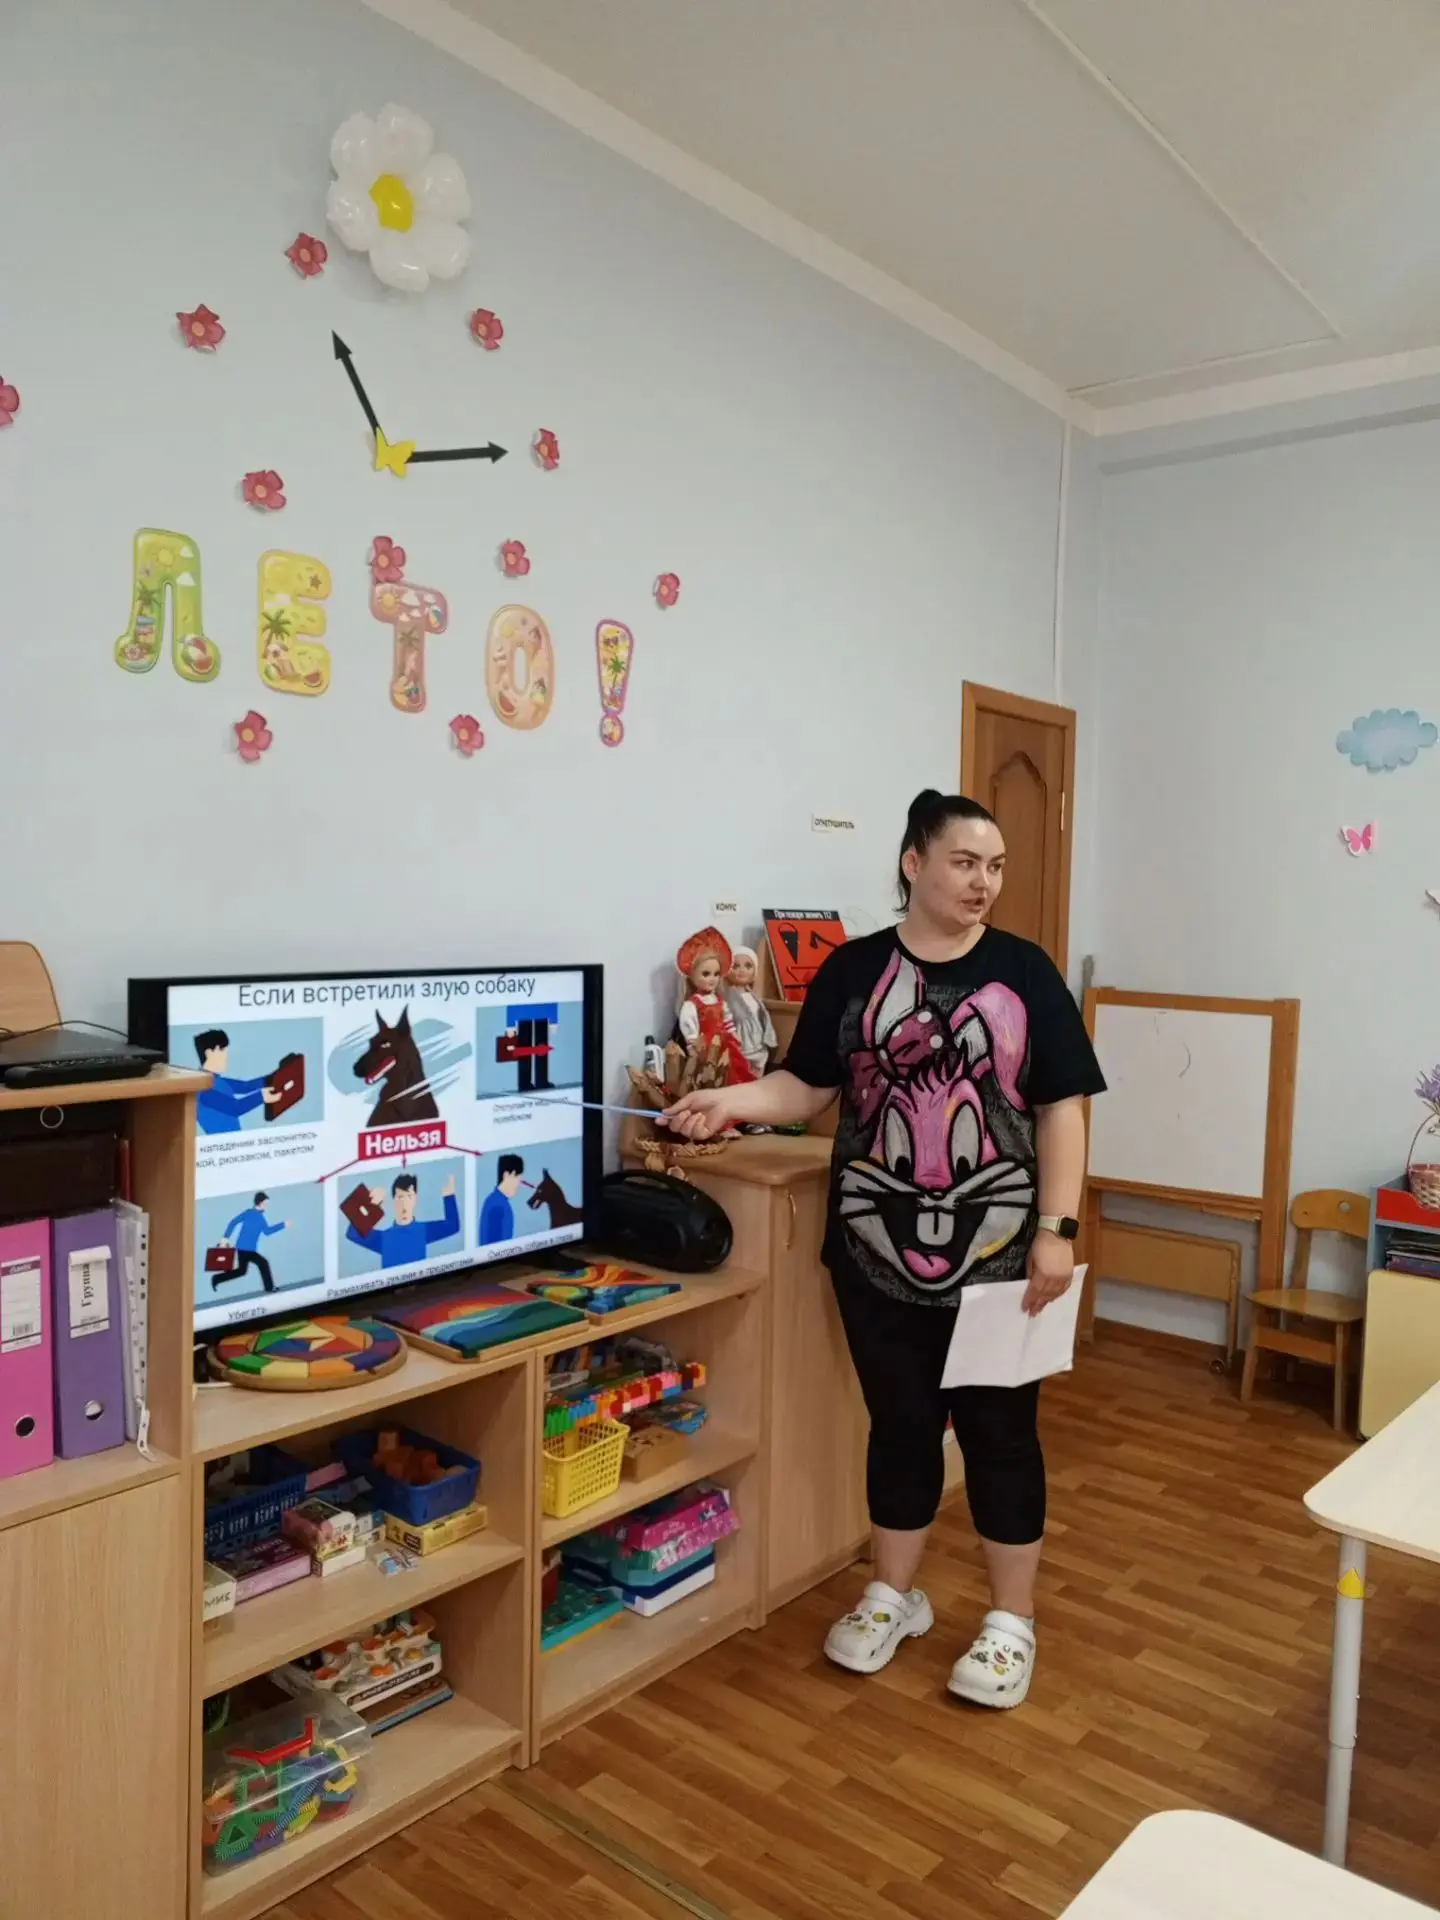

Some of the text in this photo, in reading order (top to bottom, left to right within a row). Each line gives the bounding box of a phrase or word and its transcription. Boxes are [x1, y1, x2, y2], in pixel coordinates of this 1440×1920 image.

[114, 527, 634, 747] ЛЕТО!
[239, 973, 536, 1008] Если встретили злую собаку
[365, 1129, 441, 1157] Нельзя
